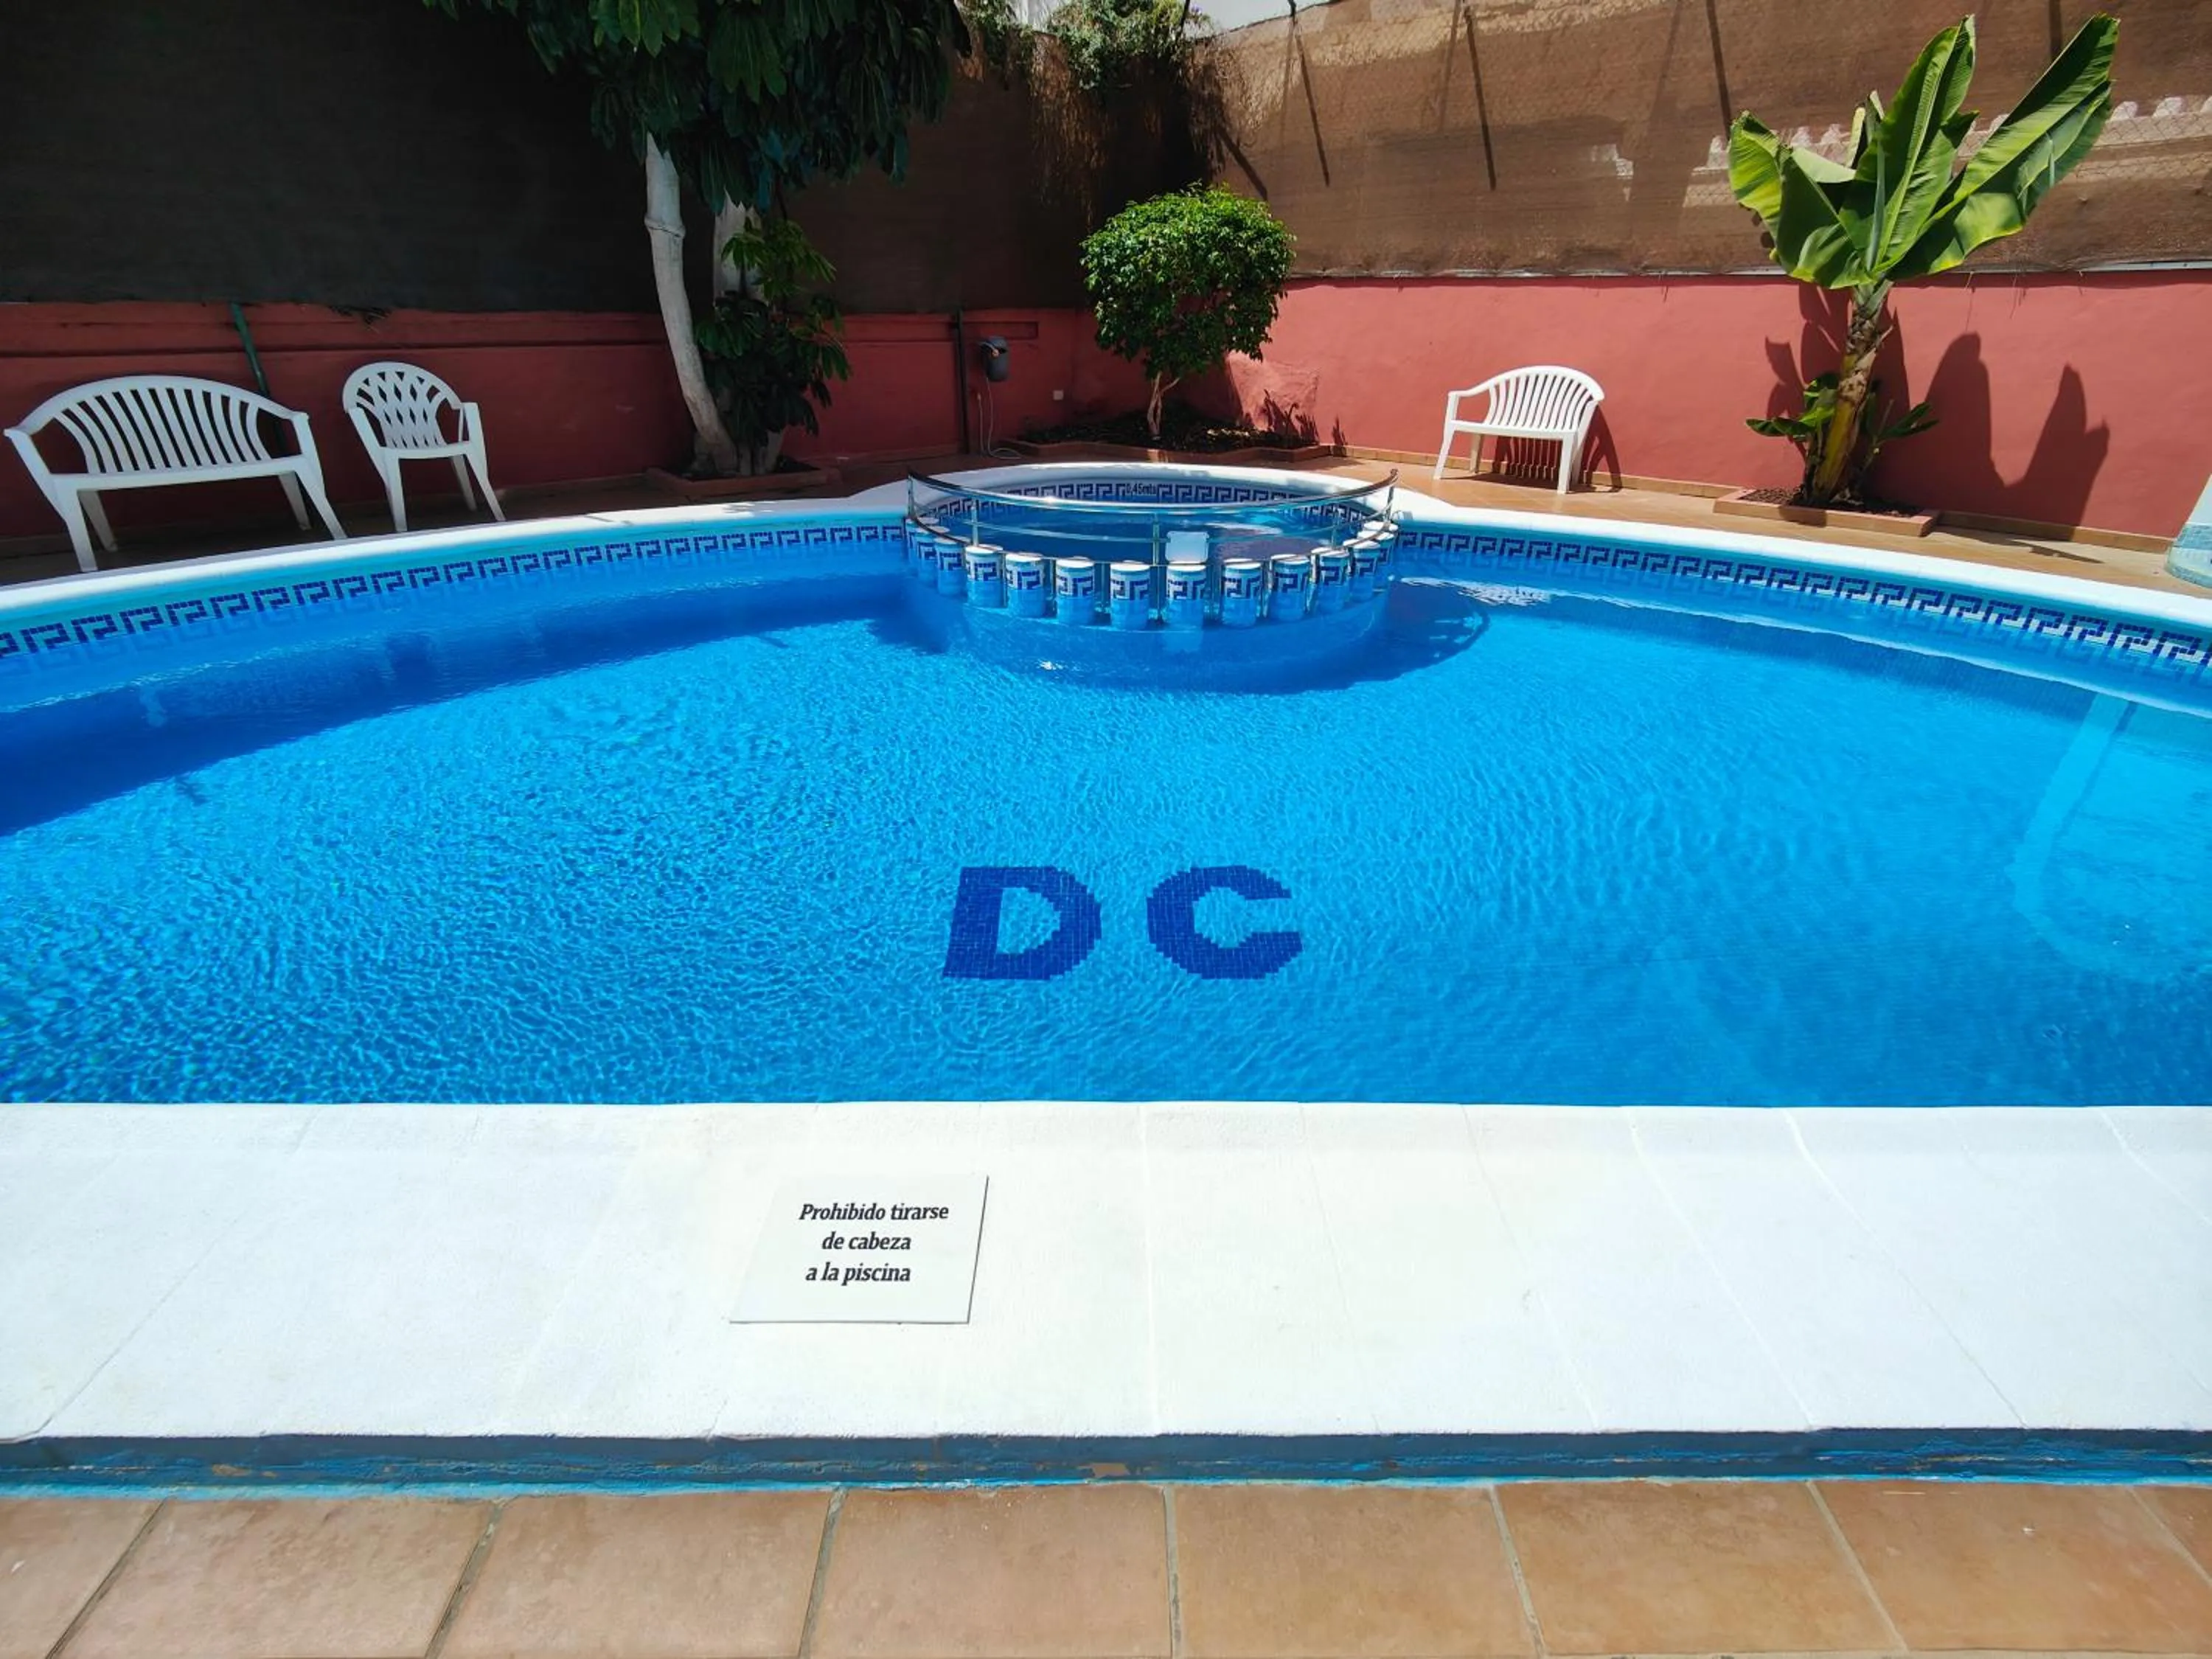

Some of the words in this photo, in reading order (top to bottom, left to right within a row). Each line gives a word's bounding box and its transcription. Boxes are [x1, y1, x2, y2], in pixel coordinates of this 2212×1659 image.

[943, 865, 1303, 981] DC
[799, 1203, 886, 1221] Prohibido
[890, 1203, 949, 1220] tirarse
[821, 1231, 845, 1251] de
[848, 1231, 911, 1251] cabeza
[805, 1267, 818, 1281] a
[820, 1261, 839, 1282] la
[841, 1263, 911, 1287] piscina
